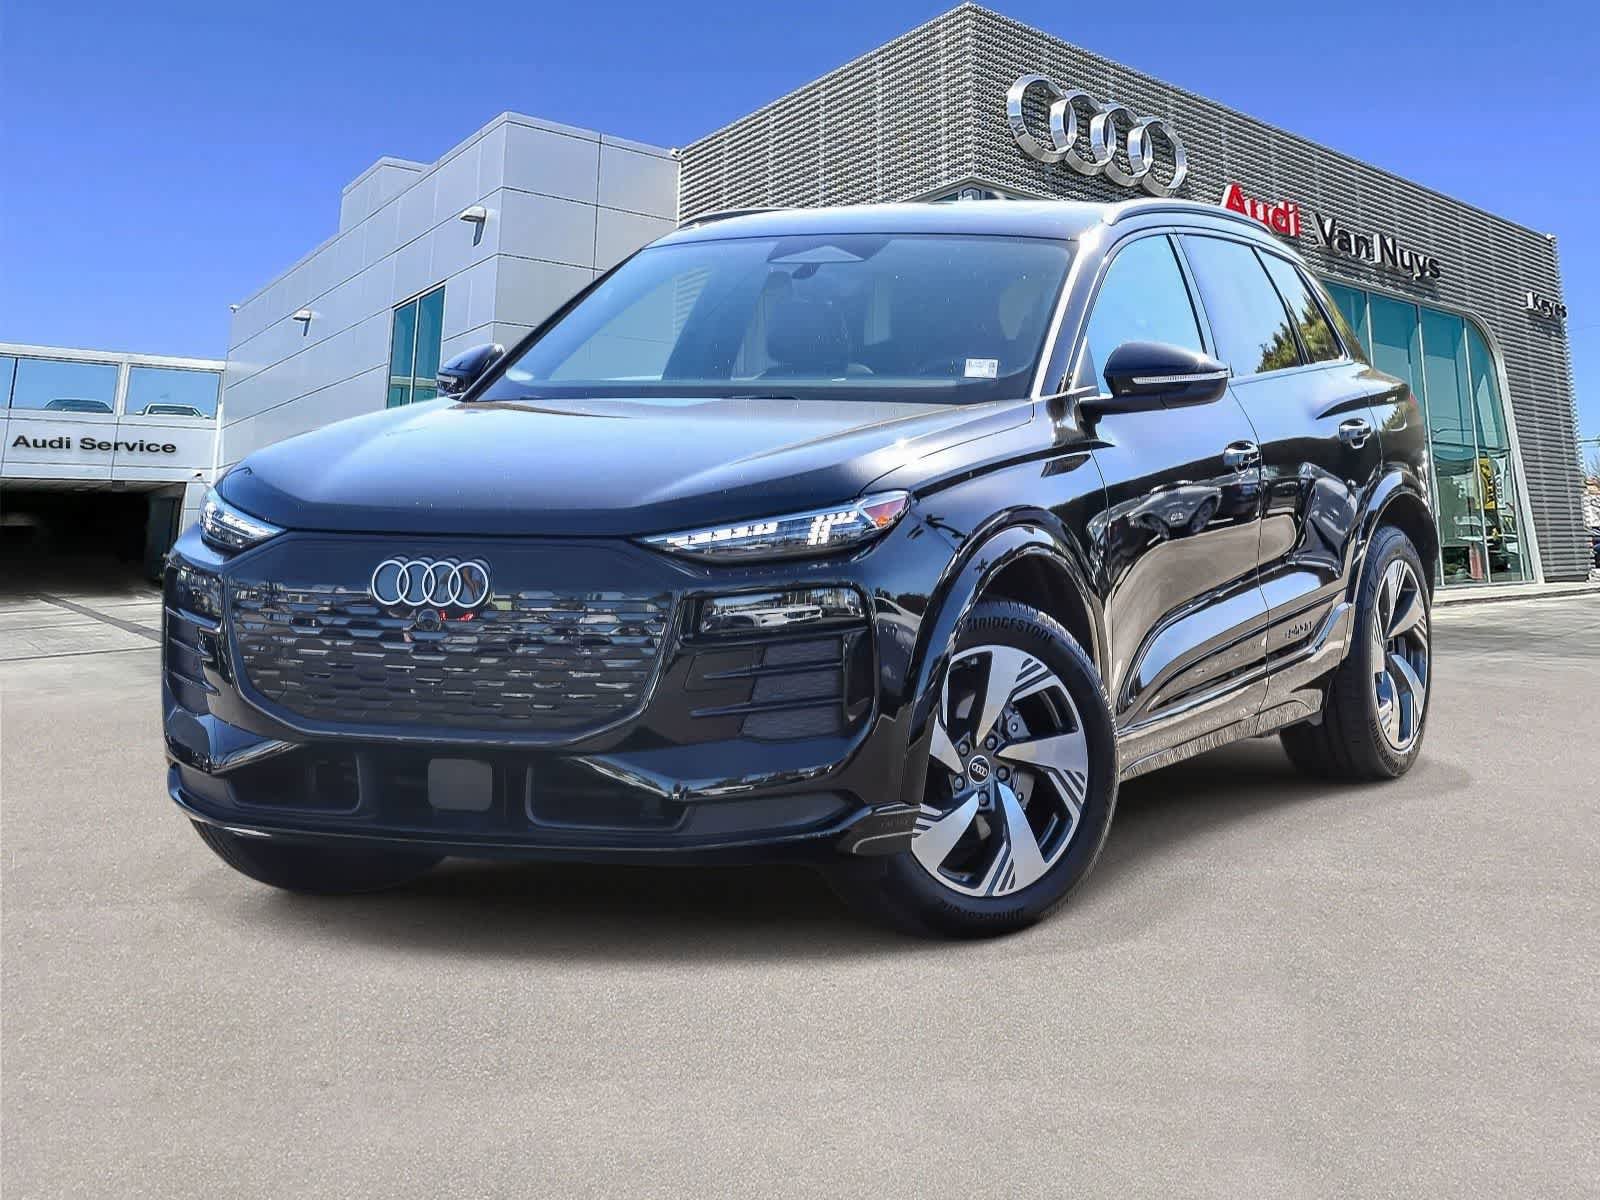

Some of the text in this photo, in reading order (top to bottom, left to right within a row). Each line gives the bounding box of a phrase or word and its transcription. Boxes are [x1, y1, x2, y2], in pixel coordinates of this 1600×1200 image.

[1221, 183, 1441, 280] Audi Van Nuys
[12, 435, 177, 453] Audi Service
